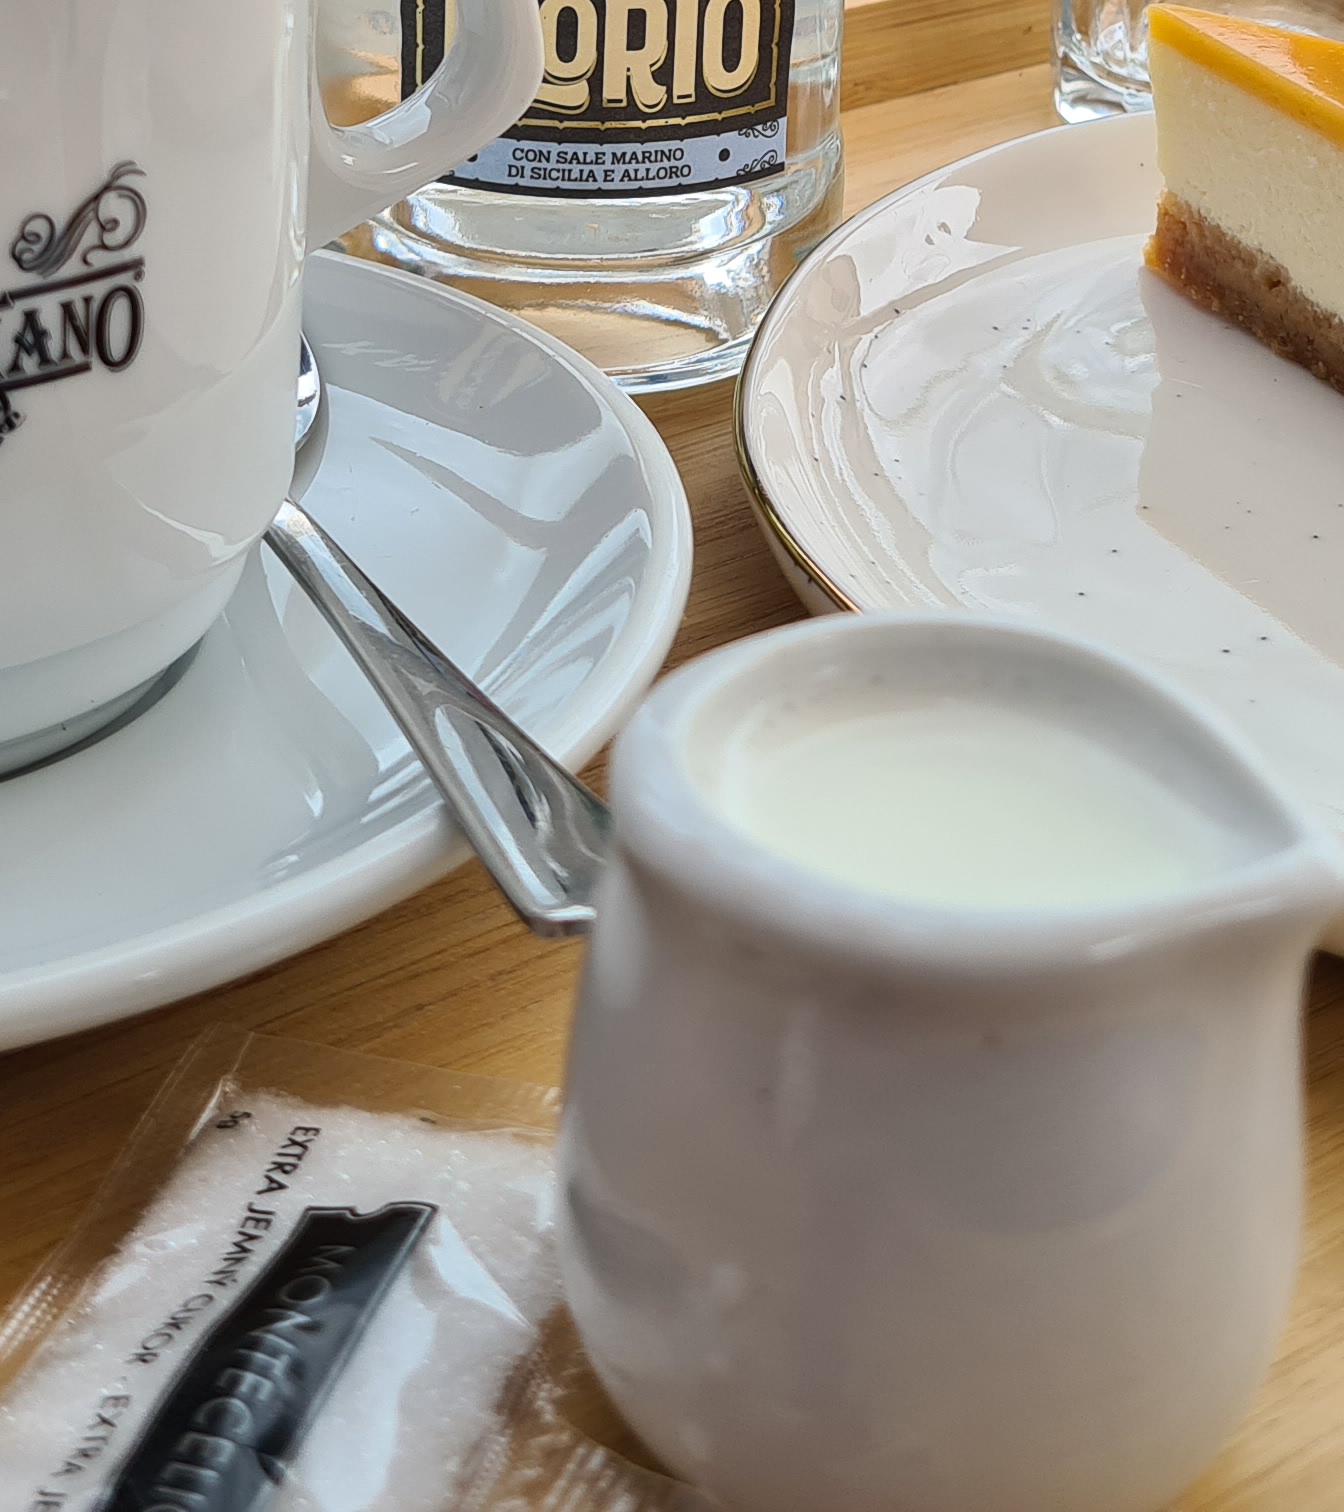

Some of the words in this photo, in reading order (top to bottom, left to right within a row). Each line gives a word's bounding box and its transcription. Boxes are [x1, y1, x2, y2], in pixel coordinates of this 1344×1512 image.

[507, 164, 525, 179] DI
[529, 167, 598, 183] SICILIA
[602, 169, 615, 183] E
[619, 164, 692, 183] ALLORO
[512, 147, 552, 163] CON
[556, 150, 606, 165] SALE
[610, 147, 685, 165] MARINO
[255, 1125, 323, 1195] EXTRA
[125, 1293, 215, 1365] CUKOR
[51, 1393, 133, 1477] EXTRA
